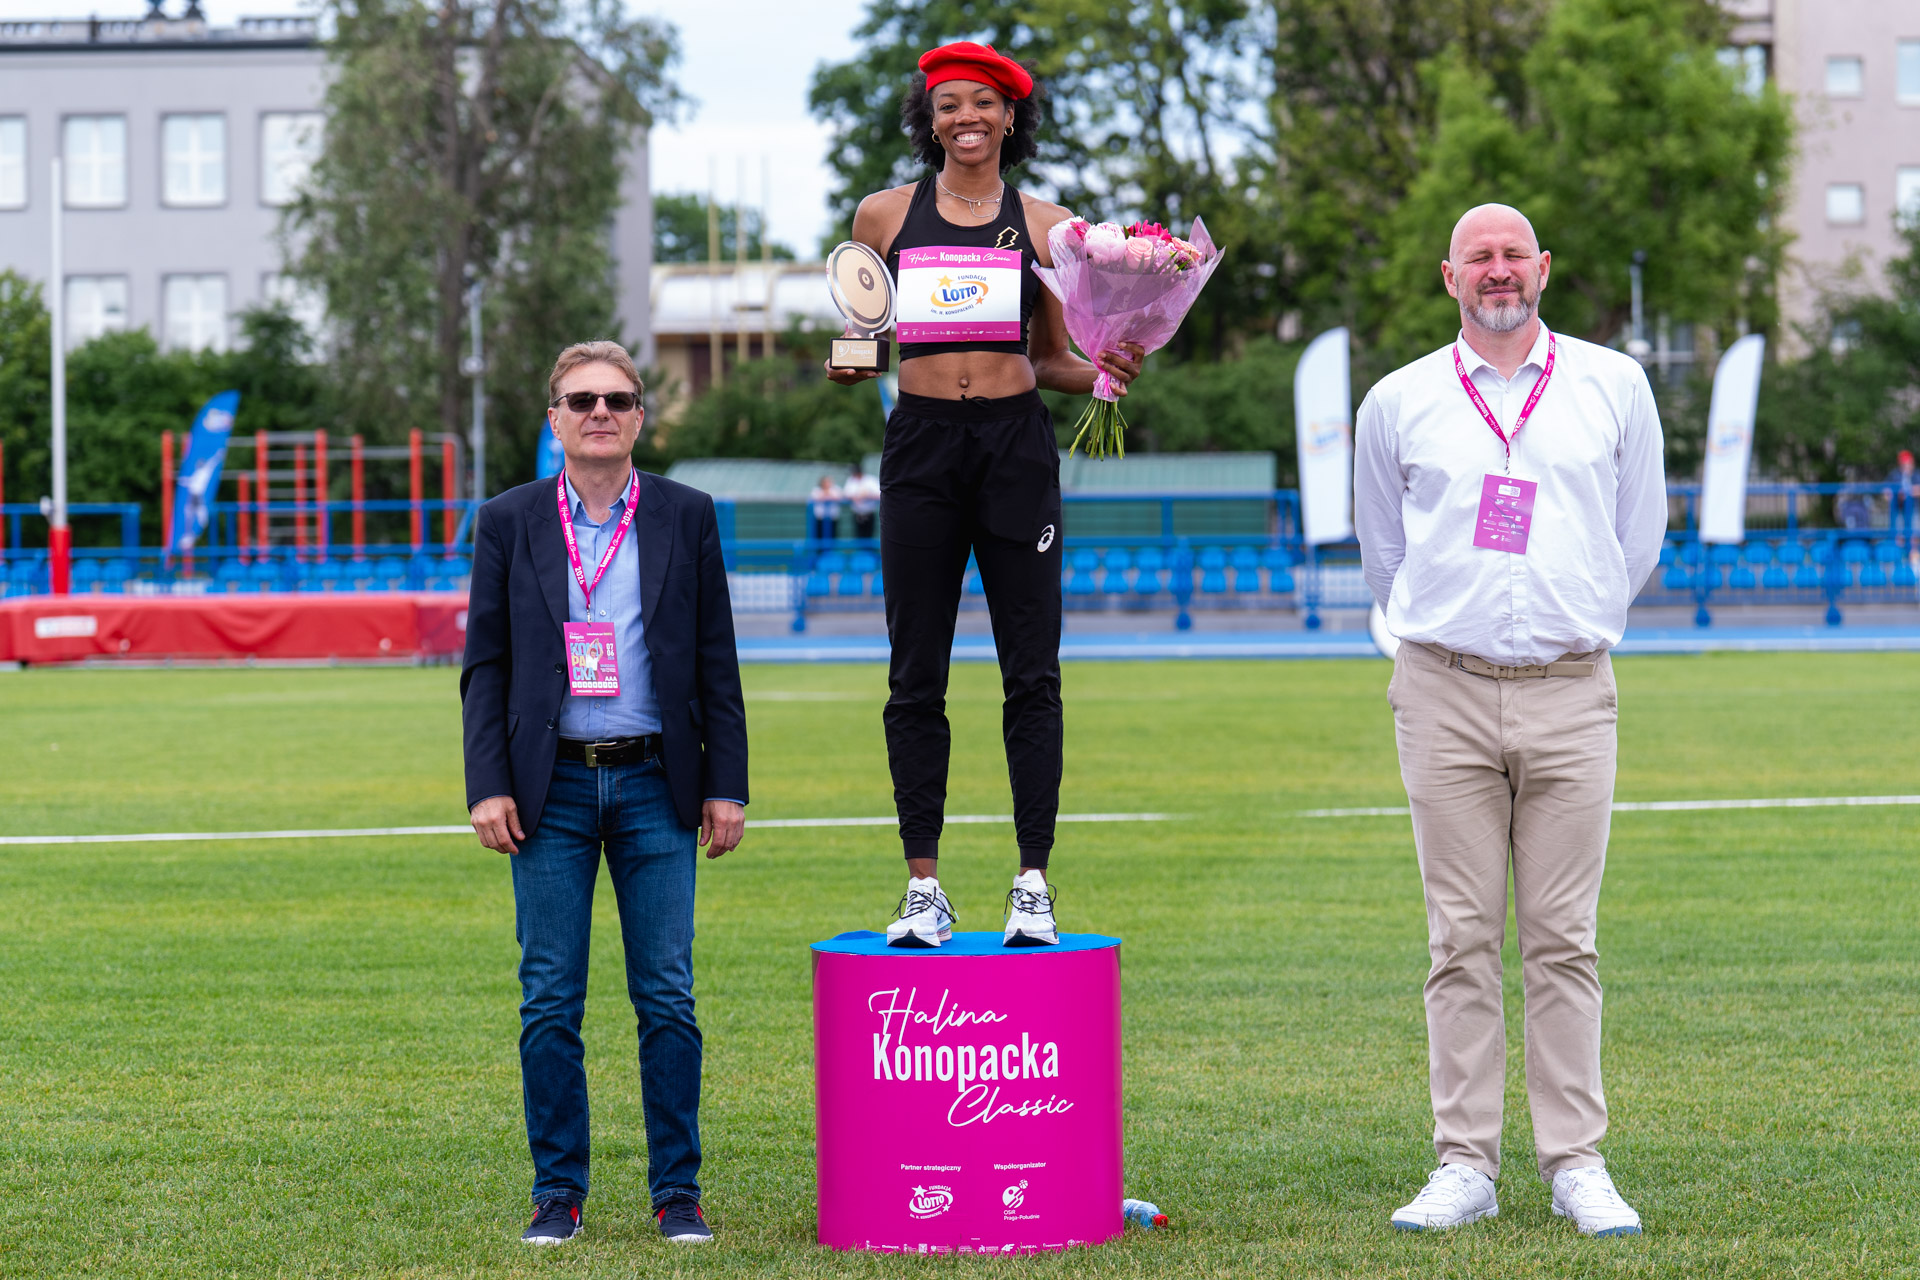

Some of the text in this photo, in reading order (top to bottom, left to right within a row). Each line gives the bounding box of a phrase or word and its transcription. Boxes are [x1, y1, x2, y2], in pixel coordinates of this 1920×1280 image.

[908, 251, 1012, 264] Halina Konopacka Classic
[942, 285, 978, 302] LOTTO
[1533, 374, 1549, 397] Konopacka
[1473, 394, 1490, 418] Konopacka
[558, 484, 566, 501] 2026
[621, 507, 634, 526] 2026
[565, 522, 575, 545] Konopacka
[600, 546, 616, 568] Konopacka
[574, 566, 584, 585] 2026
[572, 655, 586, 667] PA
[573, 667, 597, 681] CKA
[868, 987, 1008, 1045] Halina
[873, 1032, 1059, 1093] Konopacka
[947, 1084, 1075, 1127] Classic
[923, 1164, 962, 1173] strategiczny
[993, 1161, 1047, 1171] Współorganizator
[917, 1195, 945, 1209] LOTTO
[1003, 1213, 1041, 1222] Praga-Południe
